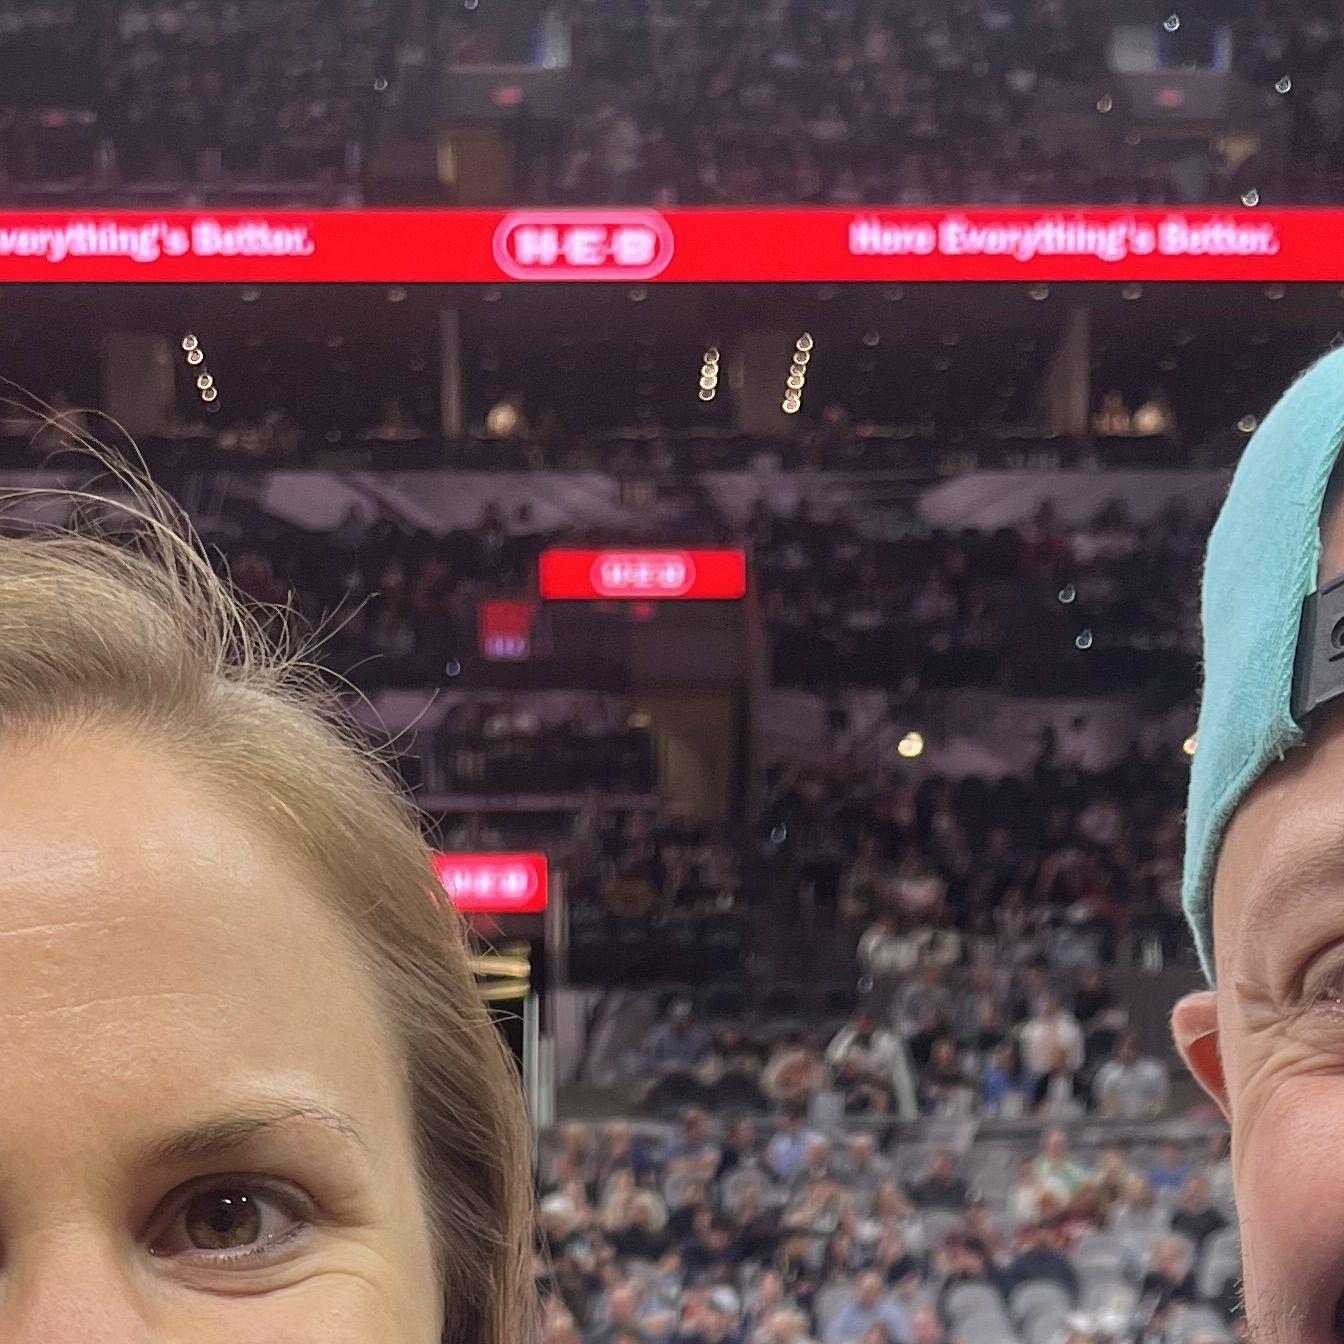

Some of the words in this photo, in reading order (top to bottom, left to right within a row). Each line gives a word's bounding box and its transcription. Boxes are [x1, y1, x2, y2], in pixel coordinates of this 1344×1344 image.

[191, 217, 315, 257] Better.
[938, 214, 1156, 262] Everything's
[1157, 214, 1280, 256] Better.
